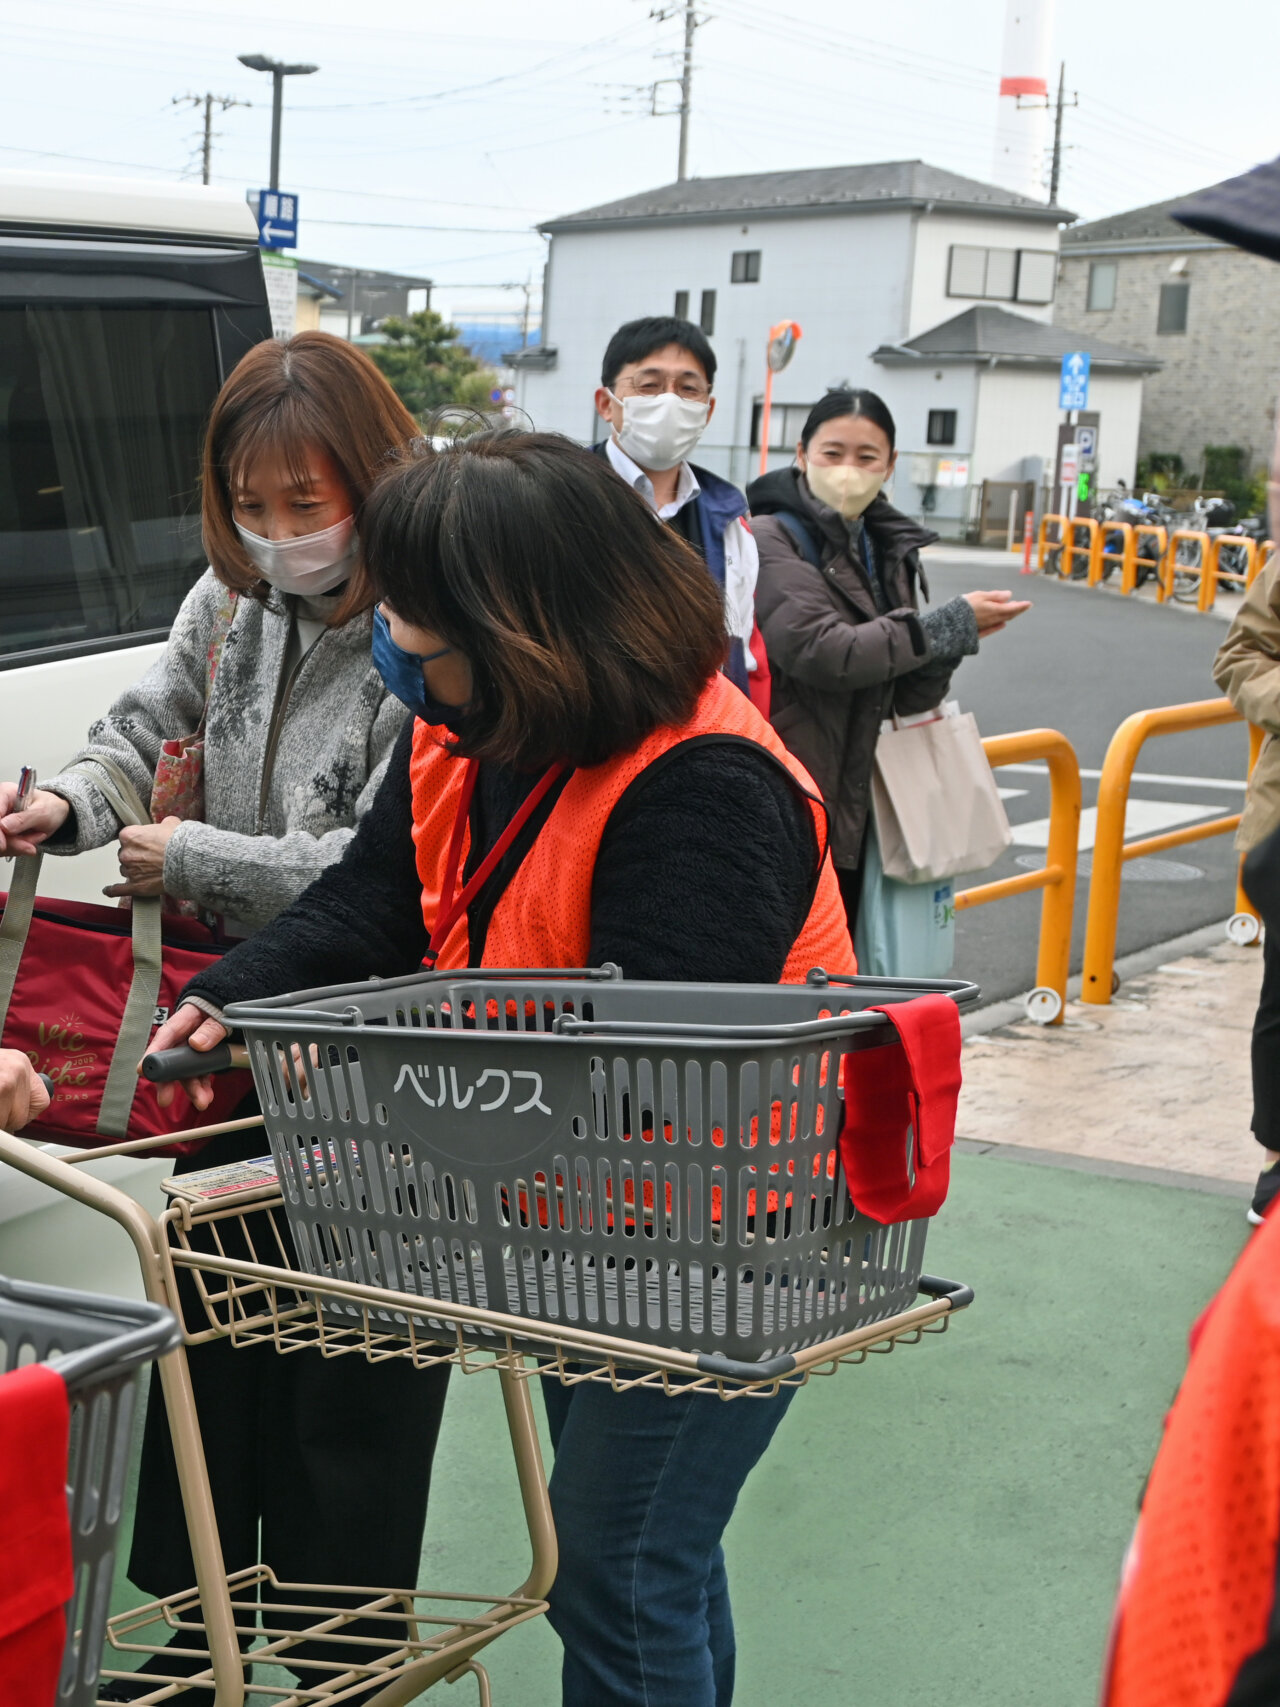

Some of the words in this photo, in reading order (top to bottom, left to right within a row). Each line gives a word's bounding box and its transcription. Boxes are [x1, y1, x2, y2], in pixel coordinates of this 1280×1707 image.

[38, 1020, 87, 1052] Vie
[53, 1093, 89, 1102] EPAS
[393, 1064, 552, 1116] ベルクス
